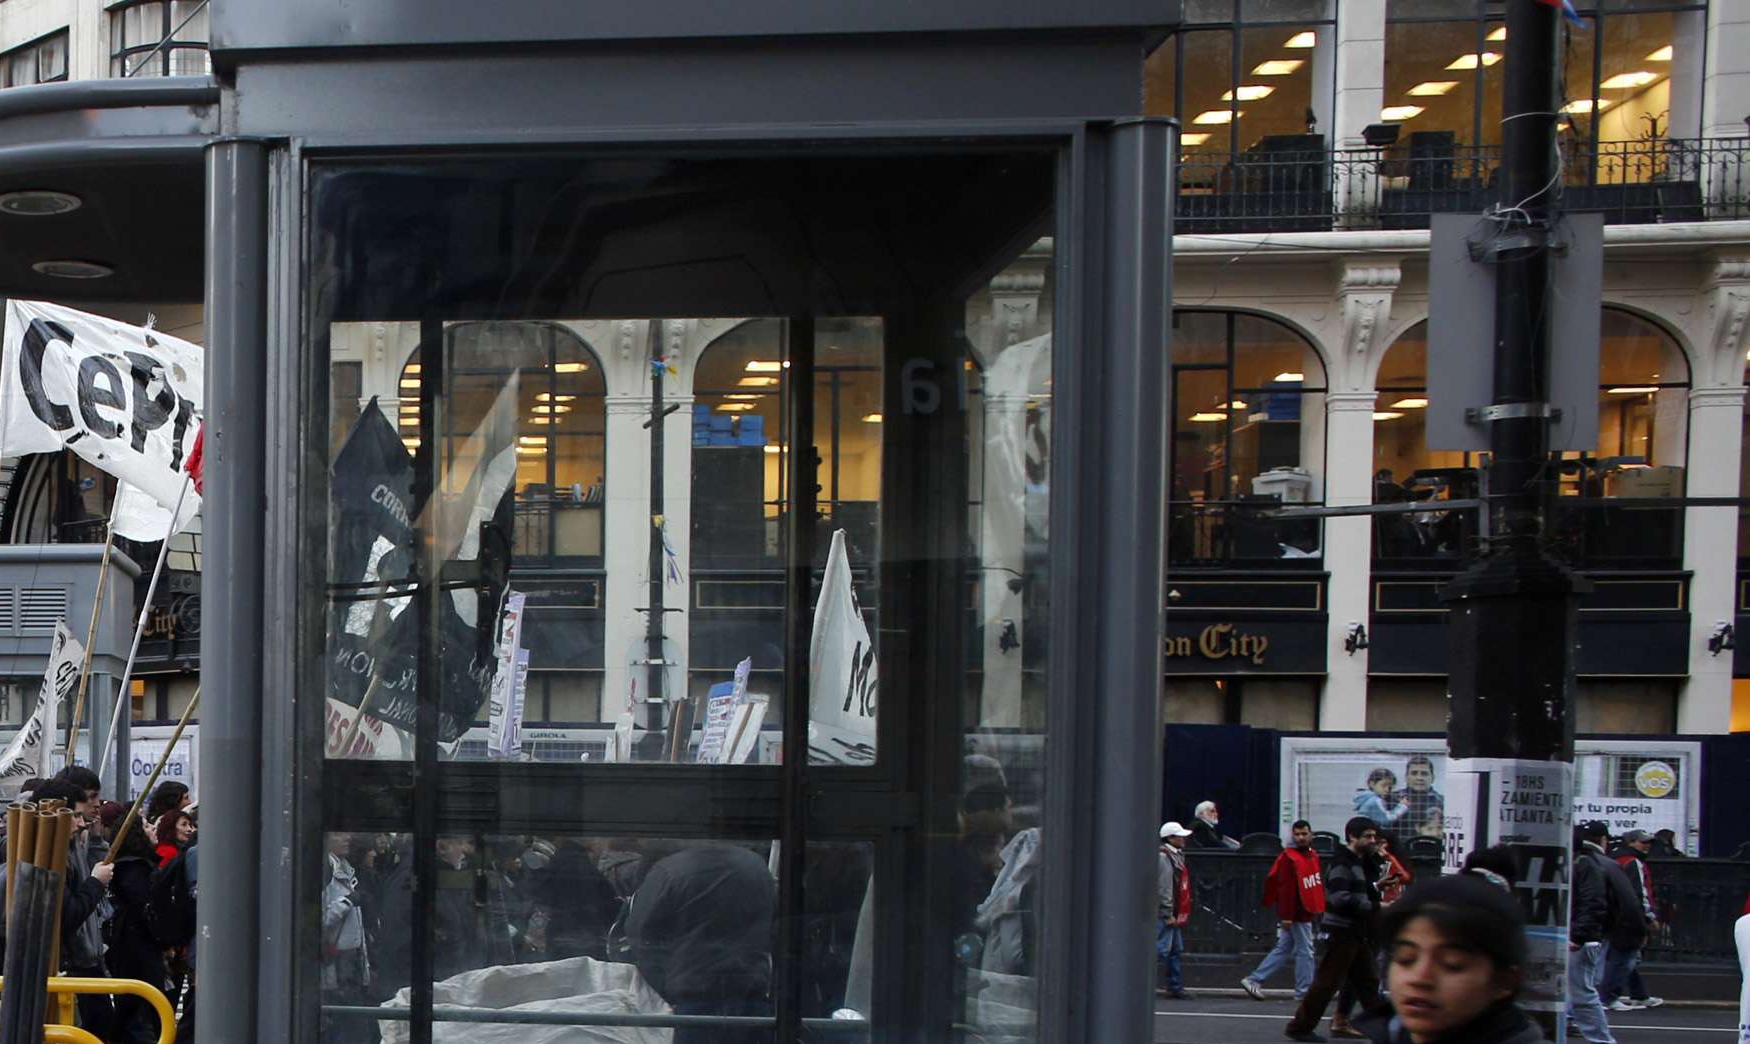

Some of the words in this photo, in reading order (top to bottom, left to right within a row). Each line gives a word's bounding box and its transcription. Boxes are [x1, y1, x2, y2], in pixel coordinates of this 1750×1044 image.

[1199, 623, 1268, 664] City
[1588, 804, 1601, 813] tu
[1606, 803, 1652, 815] propia
[1615, 820, 1637, 828] ver
